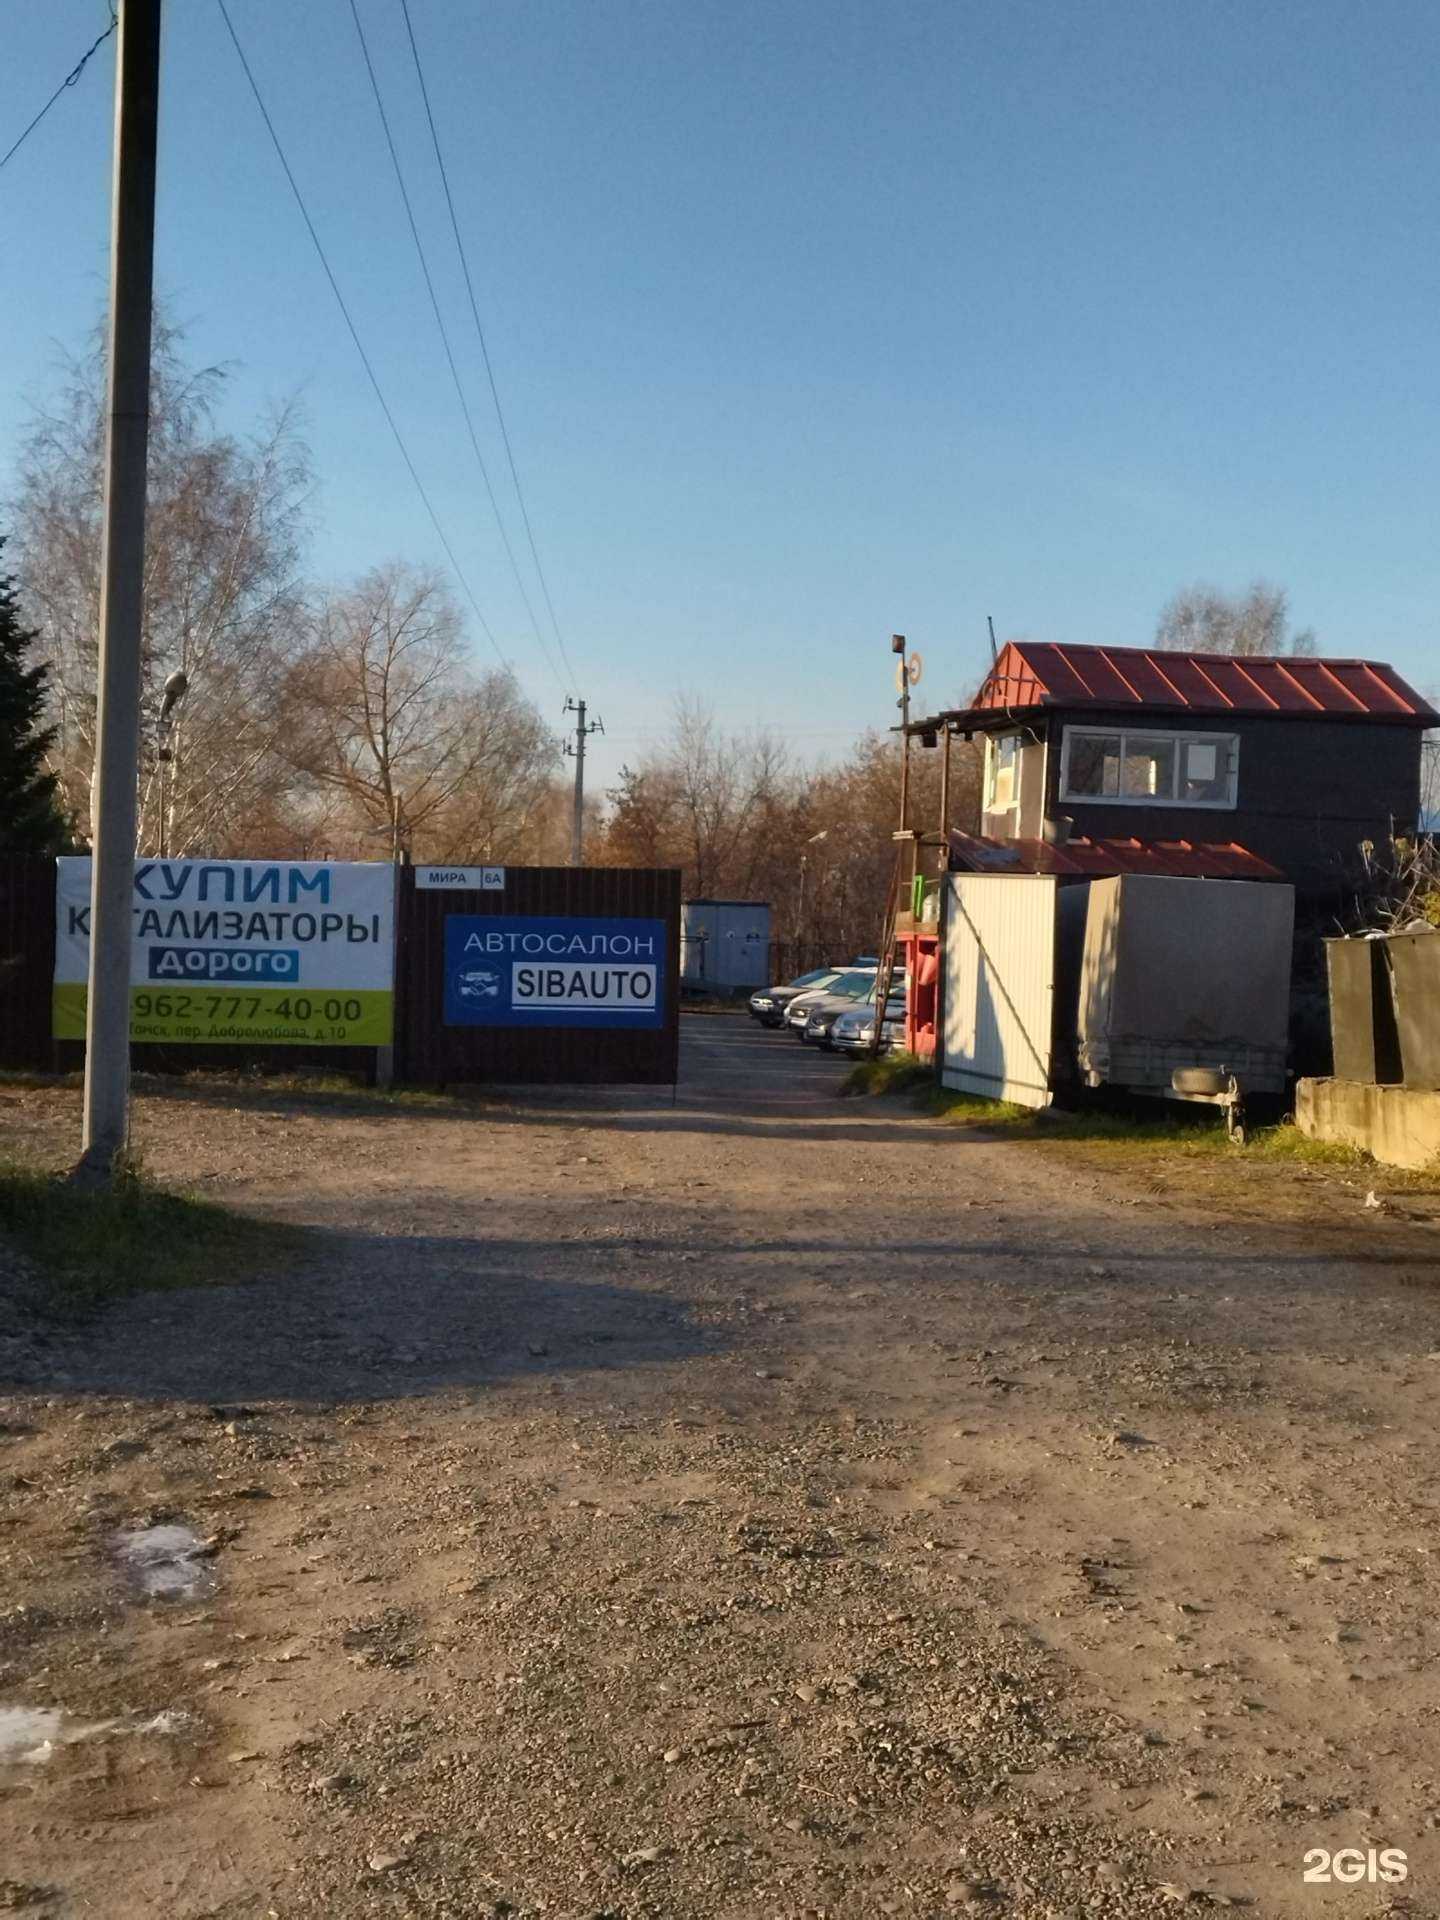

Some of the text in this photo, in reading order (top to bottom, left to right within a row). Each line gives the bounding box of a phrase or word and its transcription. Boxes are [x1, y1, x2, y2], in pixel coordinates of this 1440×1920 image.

[133, 865, 330, 904] КУПИМ
[429, 872, 467, 884] МИРА
[68, 906, 379, 943] КАЛИЗАТОРЫ
[464, 932, 654, 955] АВТОСАЛОН
[517, 968, 651, 999] SIBAUTO
